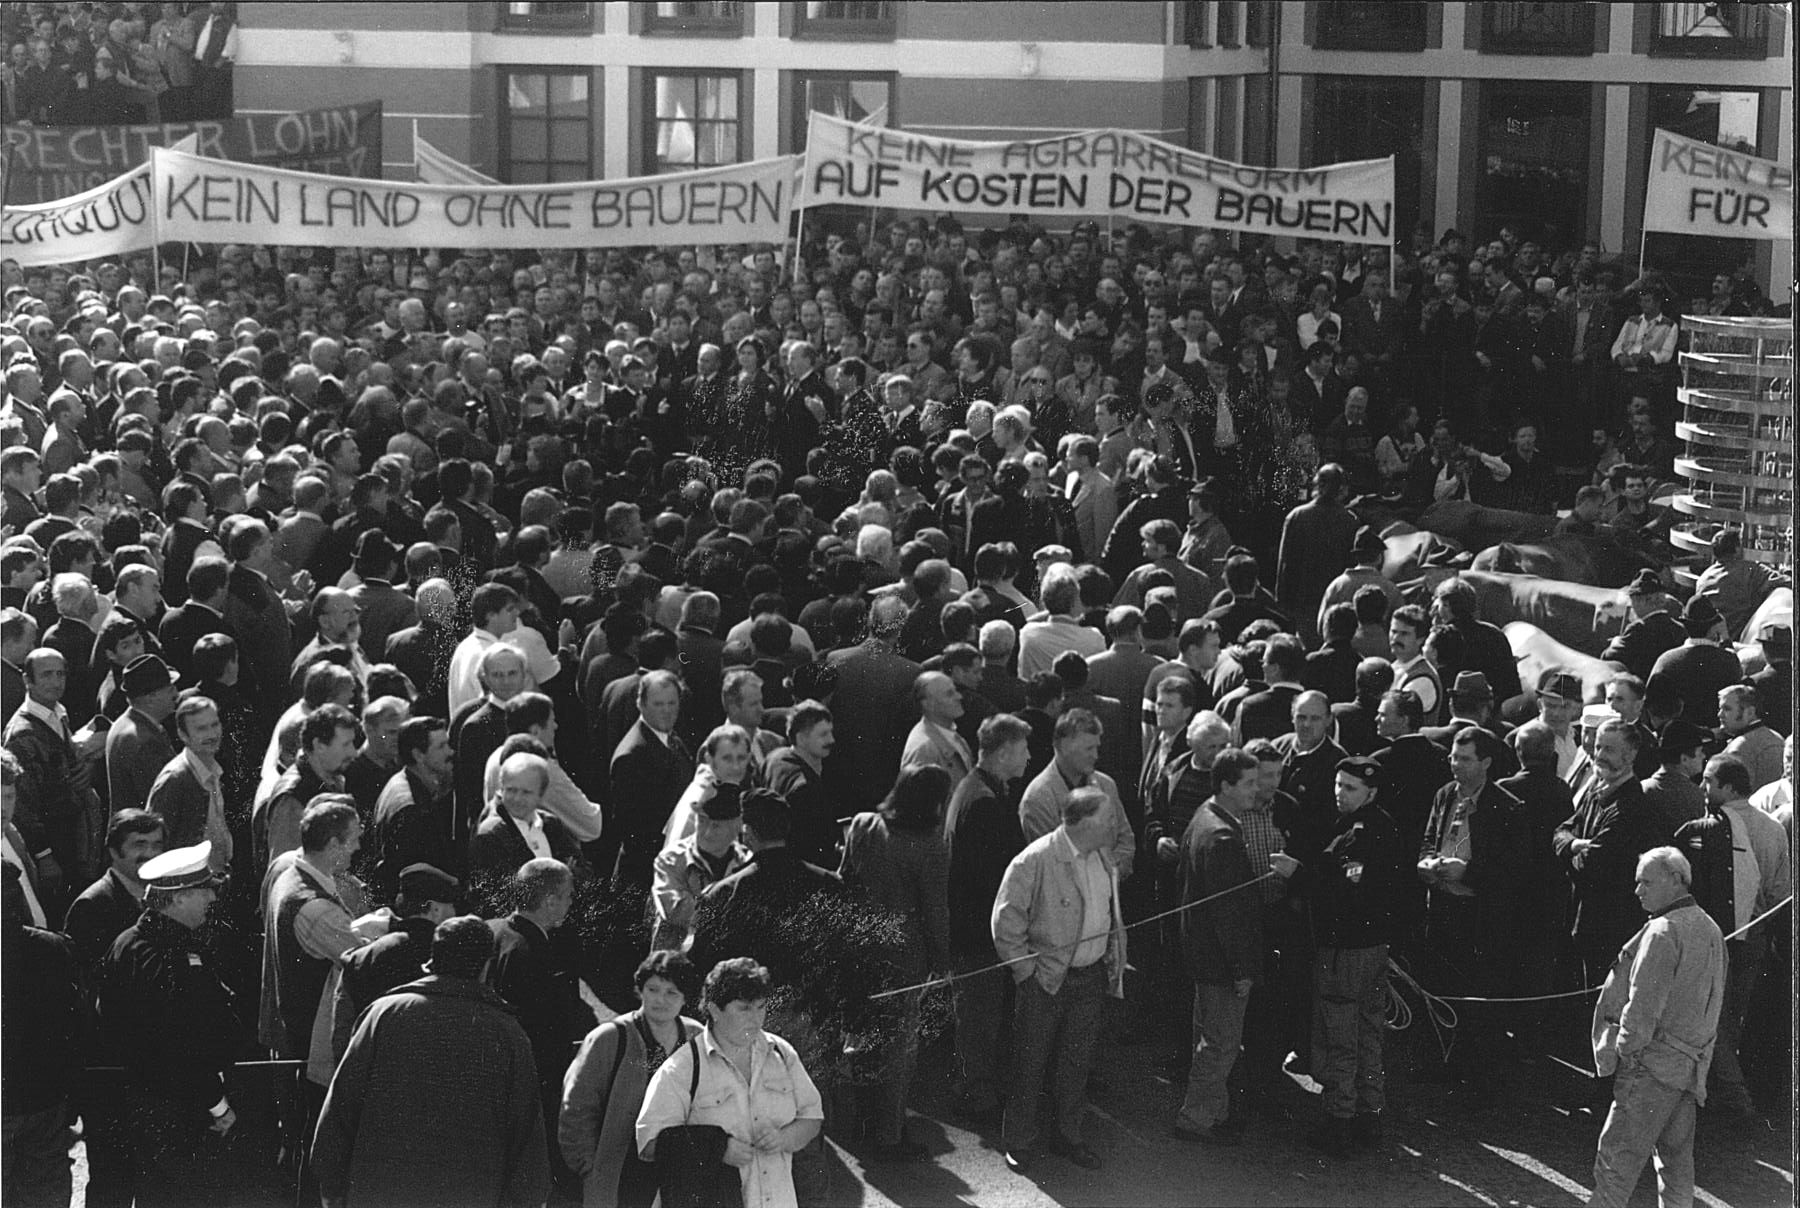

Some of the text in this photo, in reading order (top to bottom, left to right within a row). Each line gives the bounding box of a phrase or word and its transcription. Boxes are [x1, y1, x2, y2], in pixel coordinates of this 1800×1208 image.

[246, 108, 358, 157] LOHN
[849, 130, 1328, 195] KEINE AGRARREFORM
[1660, 138, 1752, 184] KEIN
[166, 174, 783, 229] KEIN LAND OHNE BAUERN
[814, 159, 1392, 237] AUF KOSTEN DER BAUERN
[1689, 187, 1770, 229] FÜR
